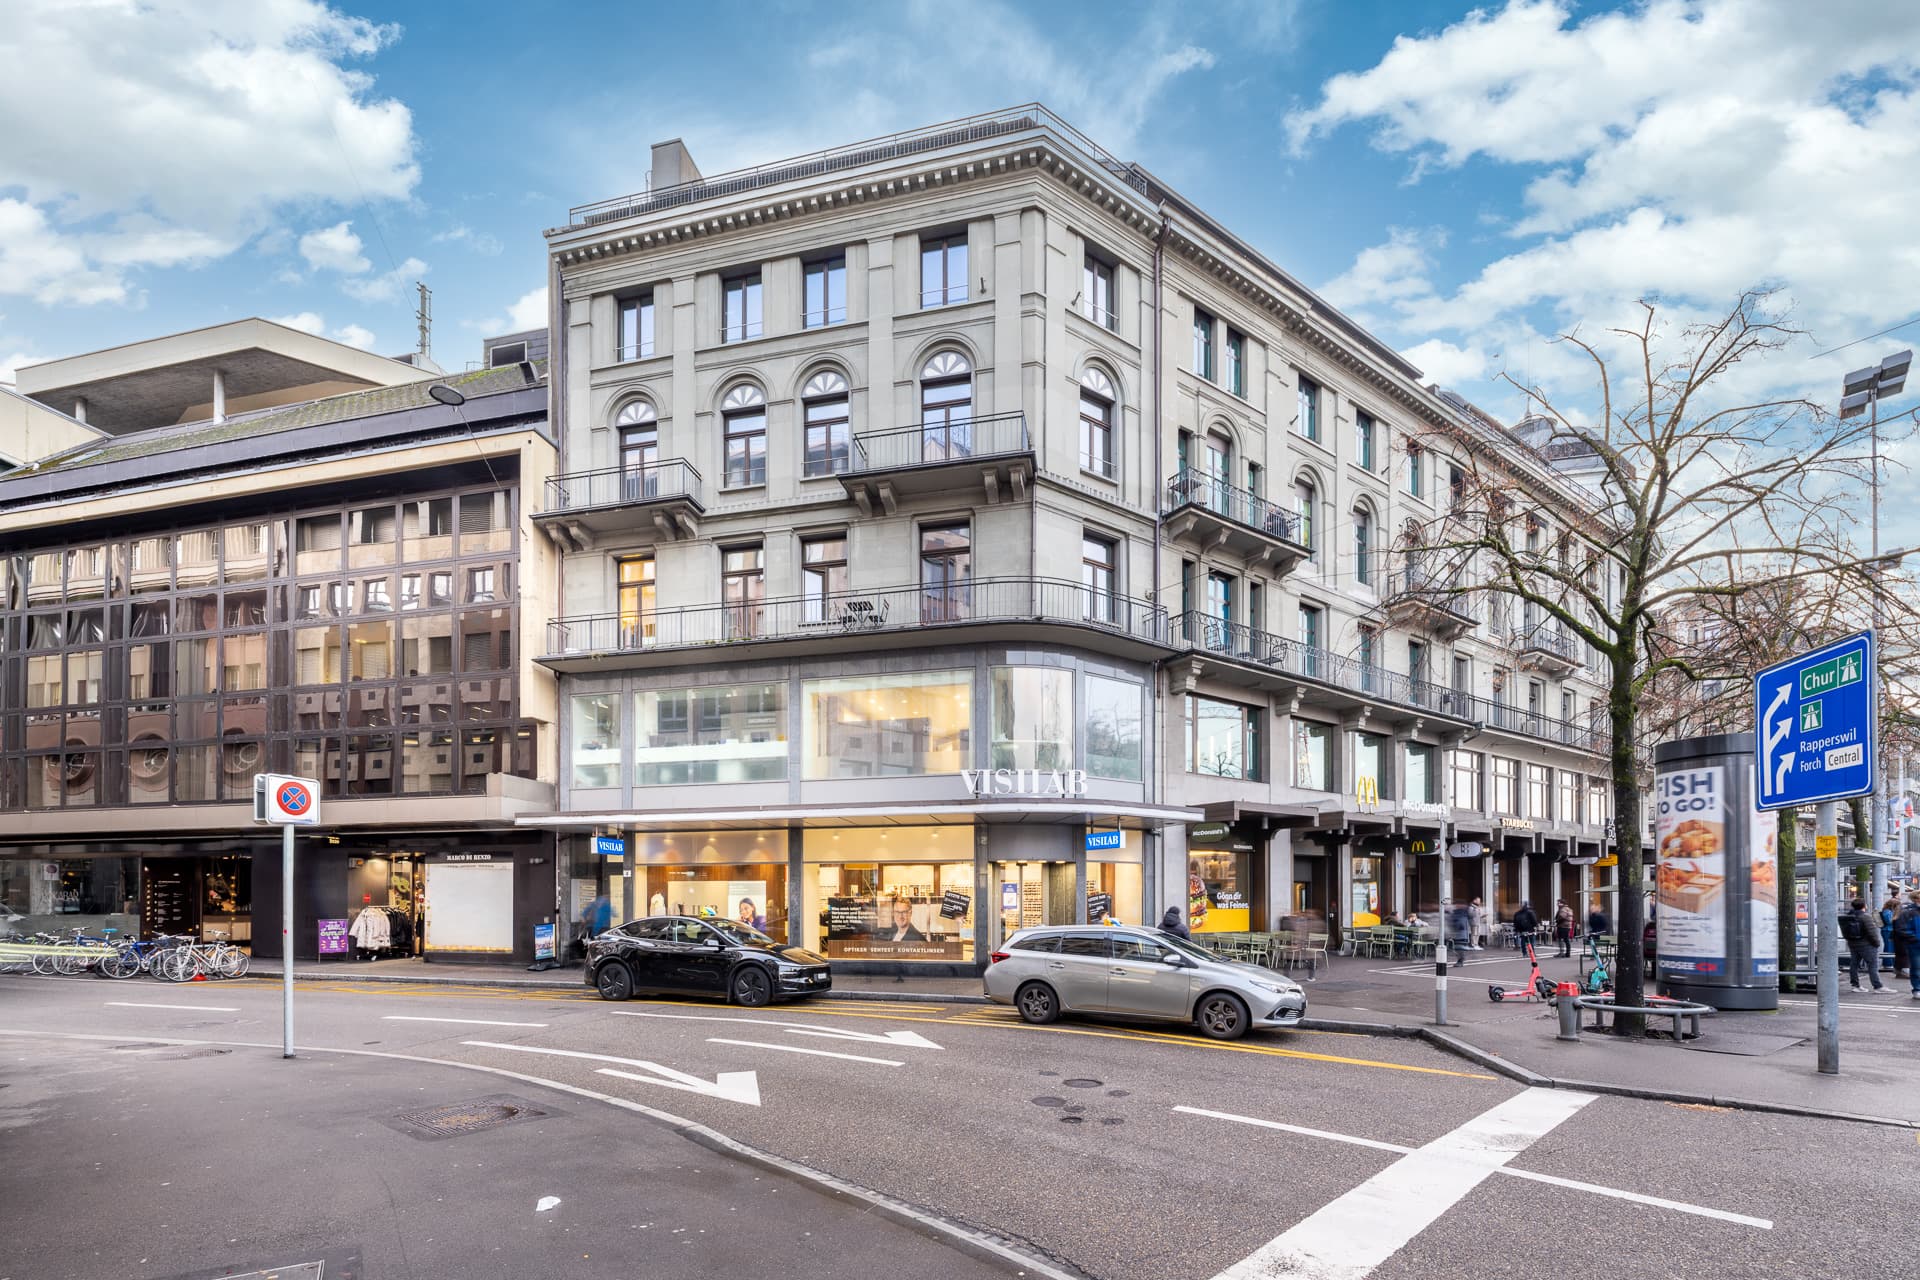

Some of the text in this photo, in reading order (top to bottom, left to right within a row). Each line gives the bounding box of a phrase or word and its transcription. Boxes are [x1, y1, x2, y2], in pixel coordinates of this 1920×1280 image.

[1803, 669, 1835, 691] Chur
[1800, 728, 1856, 753] Rapperswil
[1800, 748, 1859, 772] Forch Central
[960, 768, 1088, 795] VISILAB
[1402, 799, 1447, 815] McDonald's
[1675, 797, 1714, 812] GO!
[1502, 817, 1534, 830] STARBUCKS
[599, 840, 624, 852] VISILAB
[1087, 834, 1119, 847] VISILAB
[1233, 891, 1242, 900] dir
[1658, 960, 1697, 971] ORDSEE
